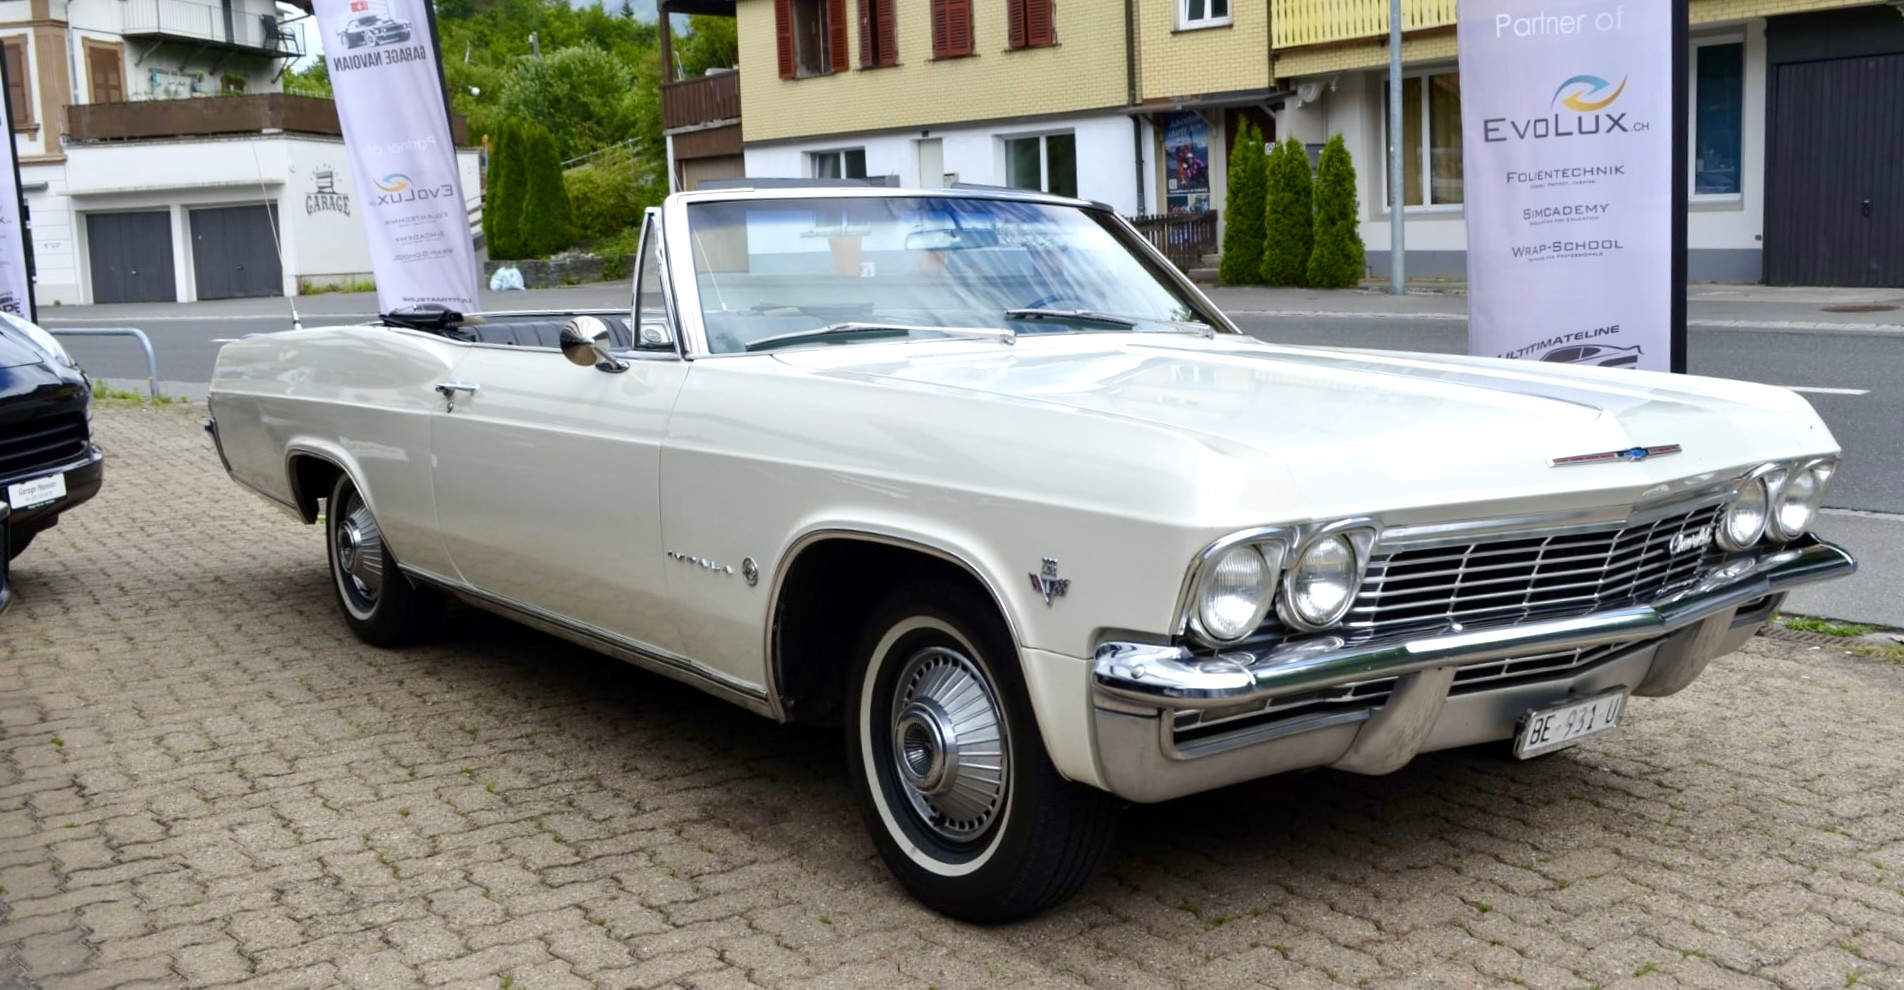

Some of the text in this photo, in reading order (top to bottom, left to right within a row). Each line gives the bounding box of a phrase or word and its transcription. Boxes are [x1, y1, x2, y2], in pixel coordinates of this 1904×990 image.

[1495, 5, 1625, 39] Partner of
[305, 195, 351, 217] GARAGE
[1530, 714, 1556, 745] BE
[1563, 704, 1598, 739] 931
